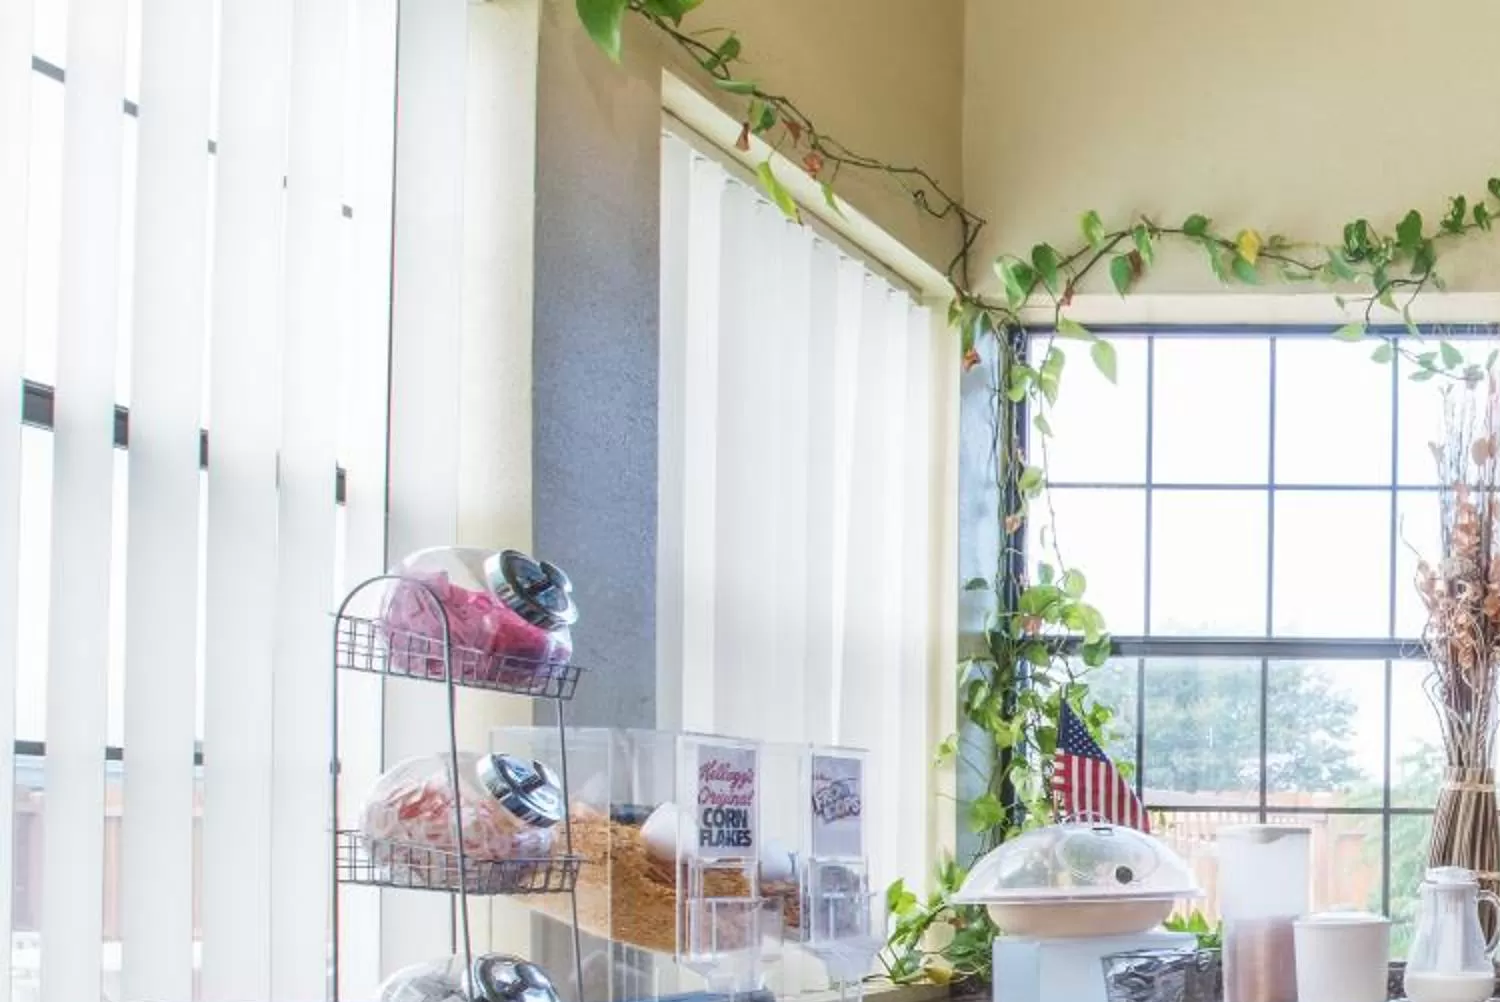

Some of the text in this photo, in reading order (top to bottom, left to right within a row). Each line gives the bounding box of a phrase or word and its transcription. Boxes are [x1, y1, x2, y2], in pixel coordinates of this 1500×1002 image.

[698, 786, 755, 808] Original
[703, 808, 748, 829] CORN
[700, 830, 752, 848] FLAKES
